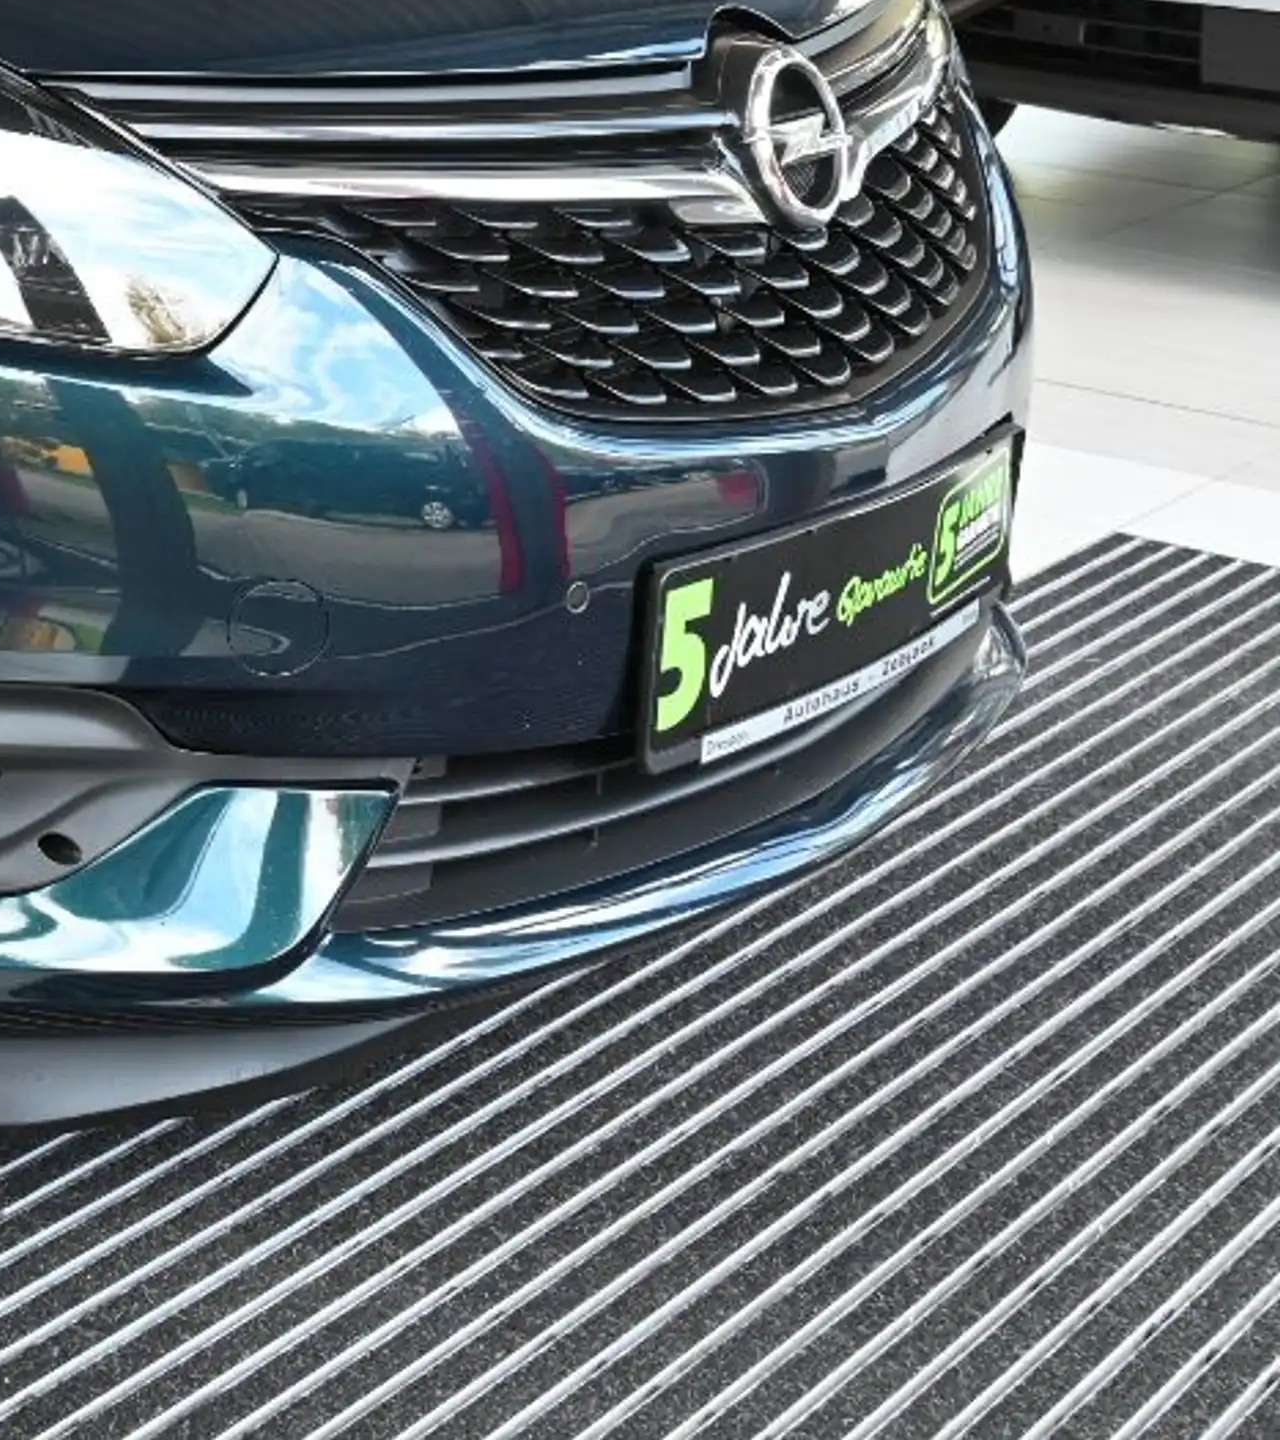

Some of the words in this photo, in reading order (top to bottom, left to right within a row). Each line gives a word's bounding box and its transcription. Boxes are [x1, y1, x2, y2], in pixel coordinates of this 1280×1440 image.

[656, 576, 714, 733] 5
[709, 571, 832, 699] Jahre
[783, 679, 860, 725] Autohaus
